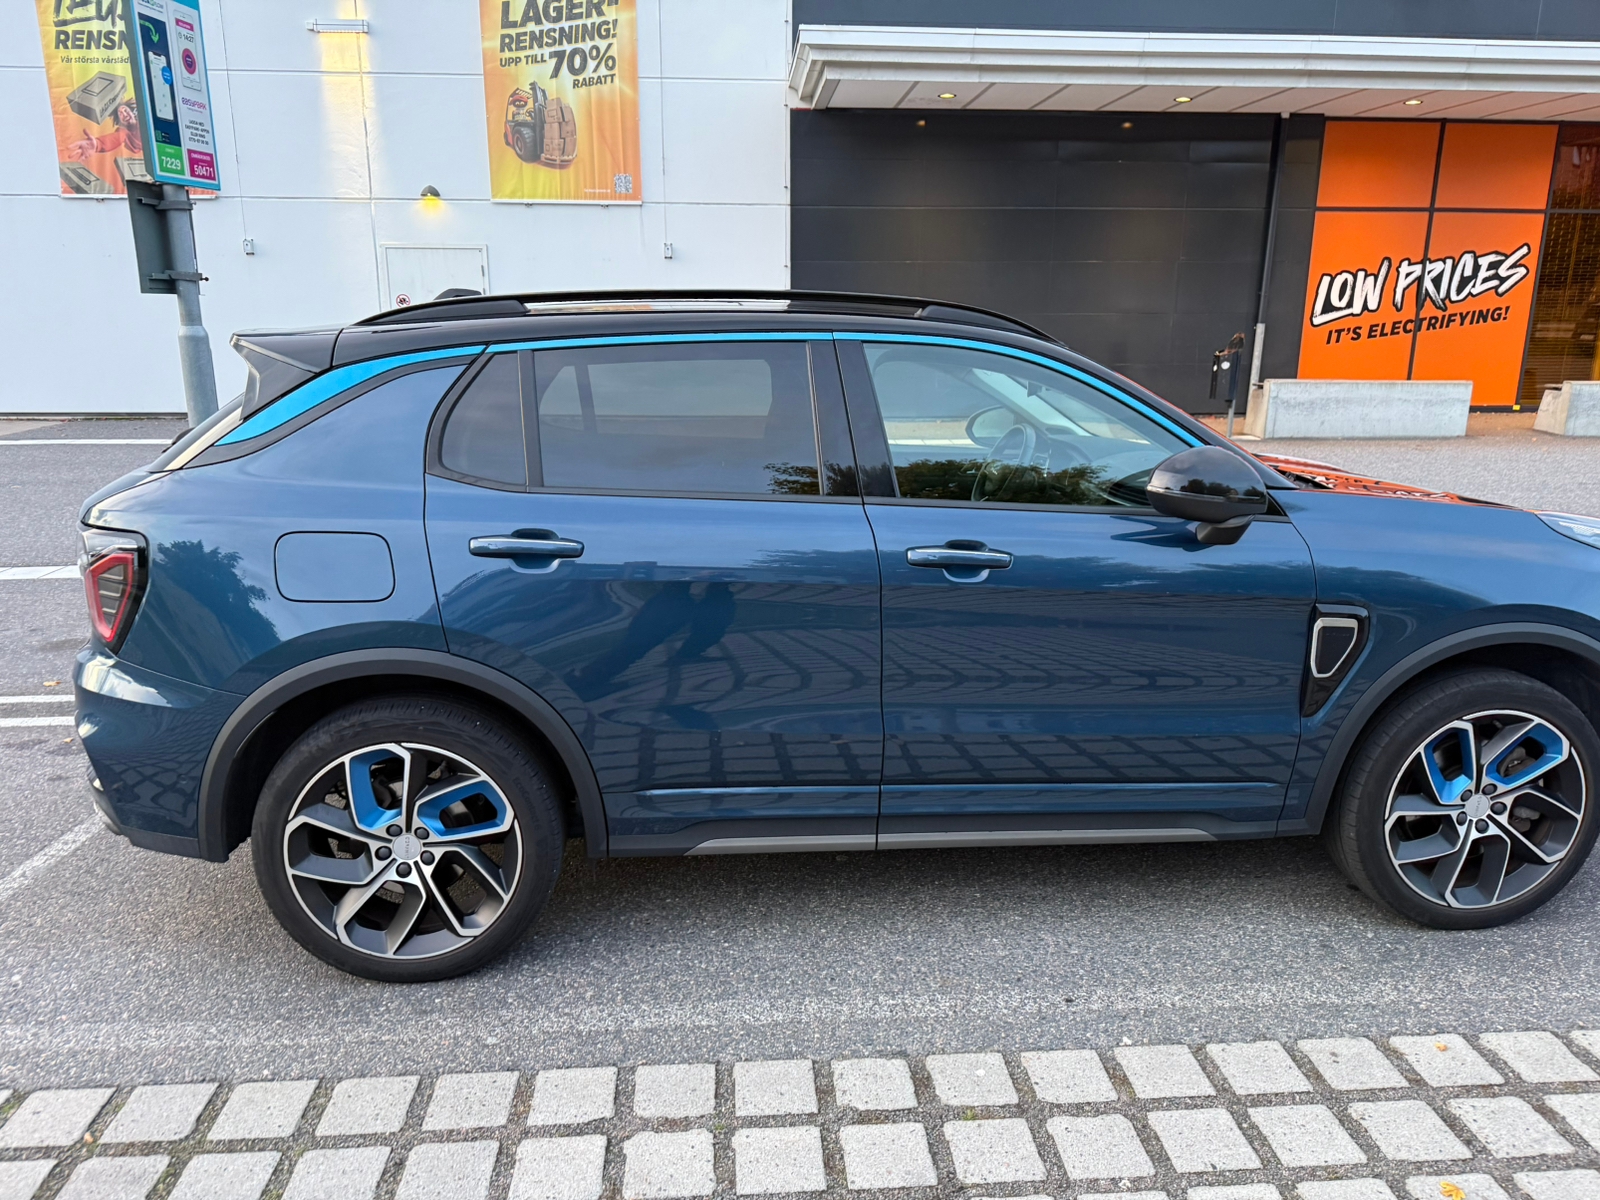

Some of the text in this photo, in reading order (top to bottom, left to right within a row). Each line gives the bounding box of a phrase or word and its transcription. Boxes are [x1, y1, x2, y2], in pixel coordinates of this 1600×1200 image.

[499, 19, 618, 53] RENSNING!
[60, 55, 72, 63] Vår
[499, 42, 617, 80] UPP TILL 70%
[572, 74, 616, 89] RABATT
[161, 156, 181, 170] 7229
[193, 164, 214, 178] 50471
[1310, 243, 1531, 328] LOW PRICES
[1326, 305, 1511, 345] IT'S ELECTRIFYING!
